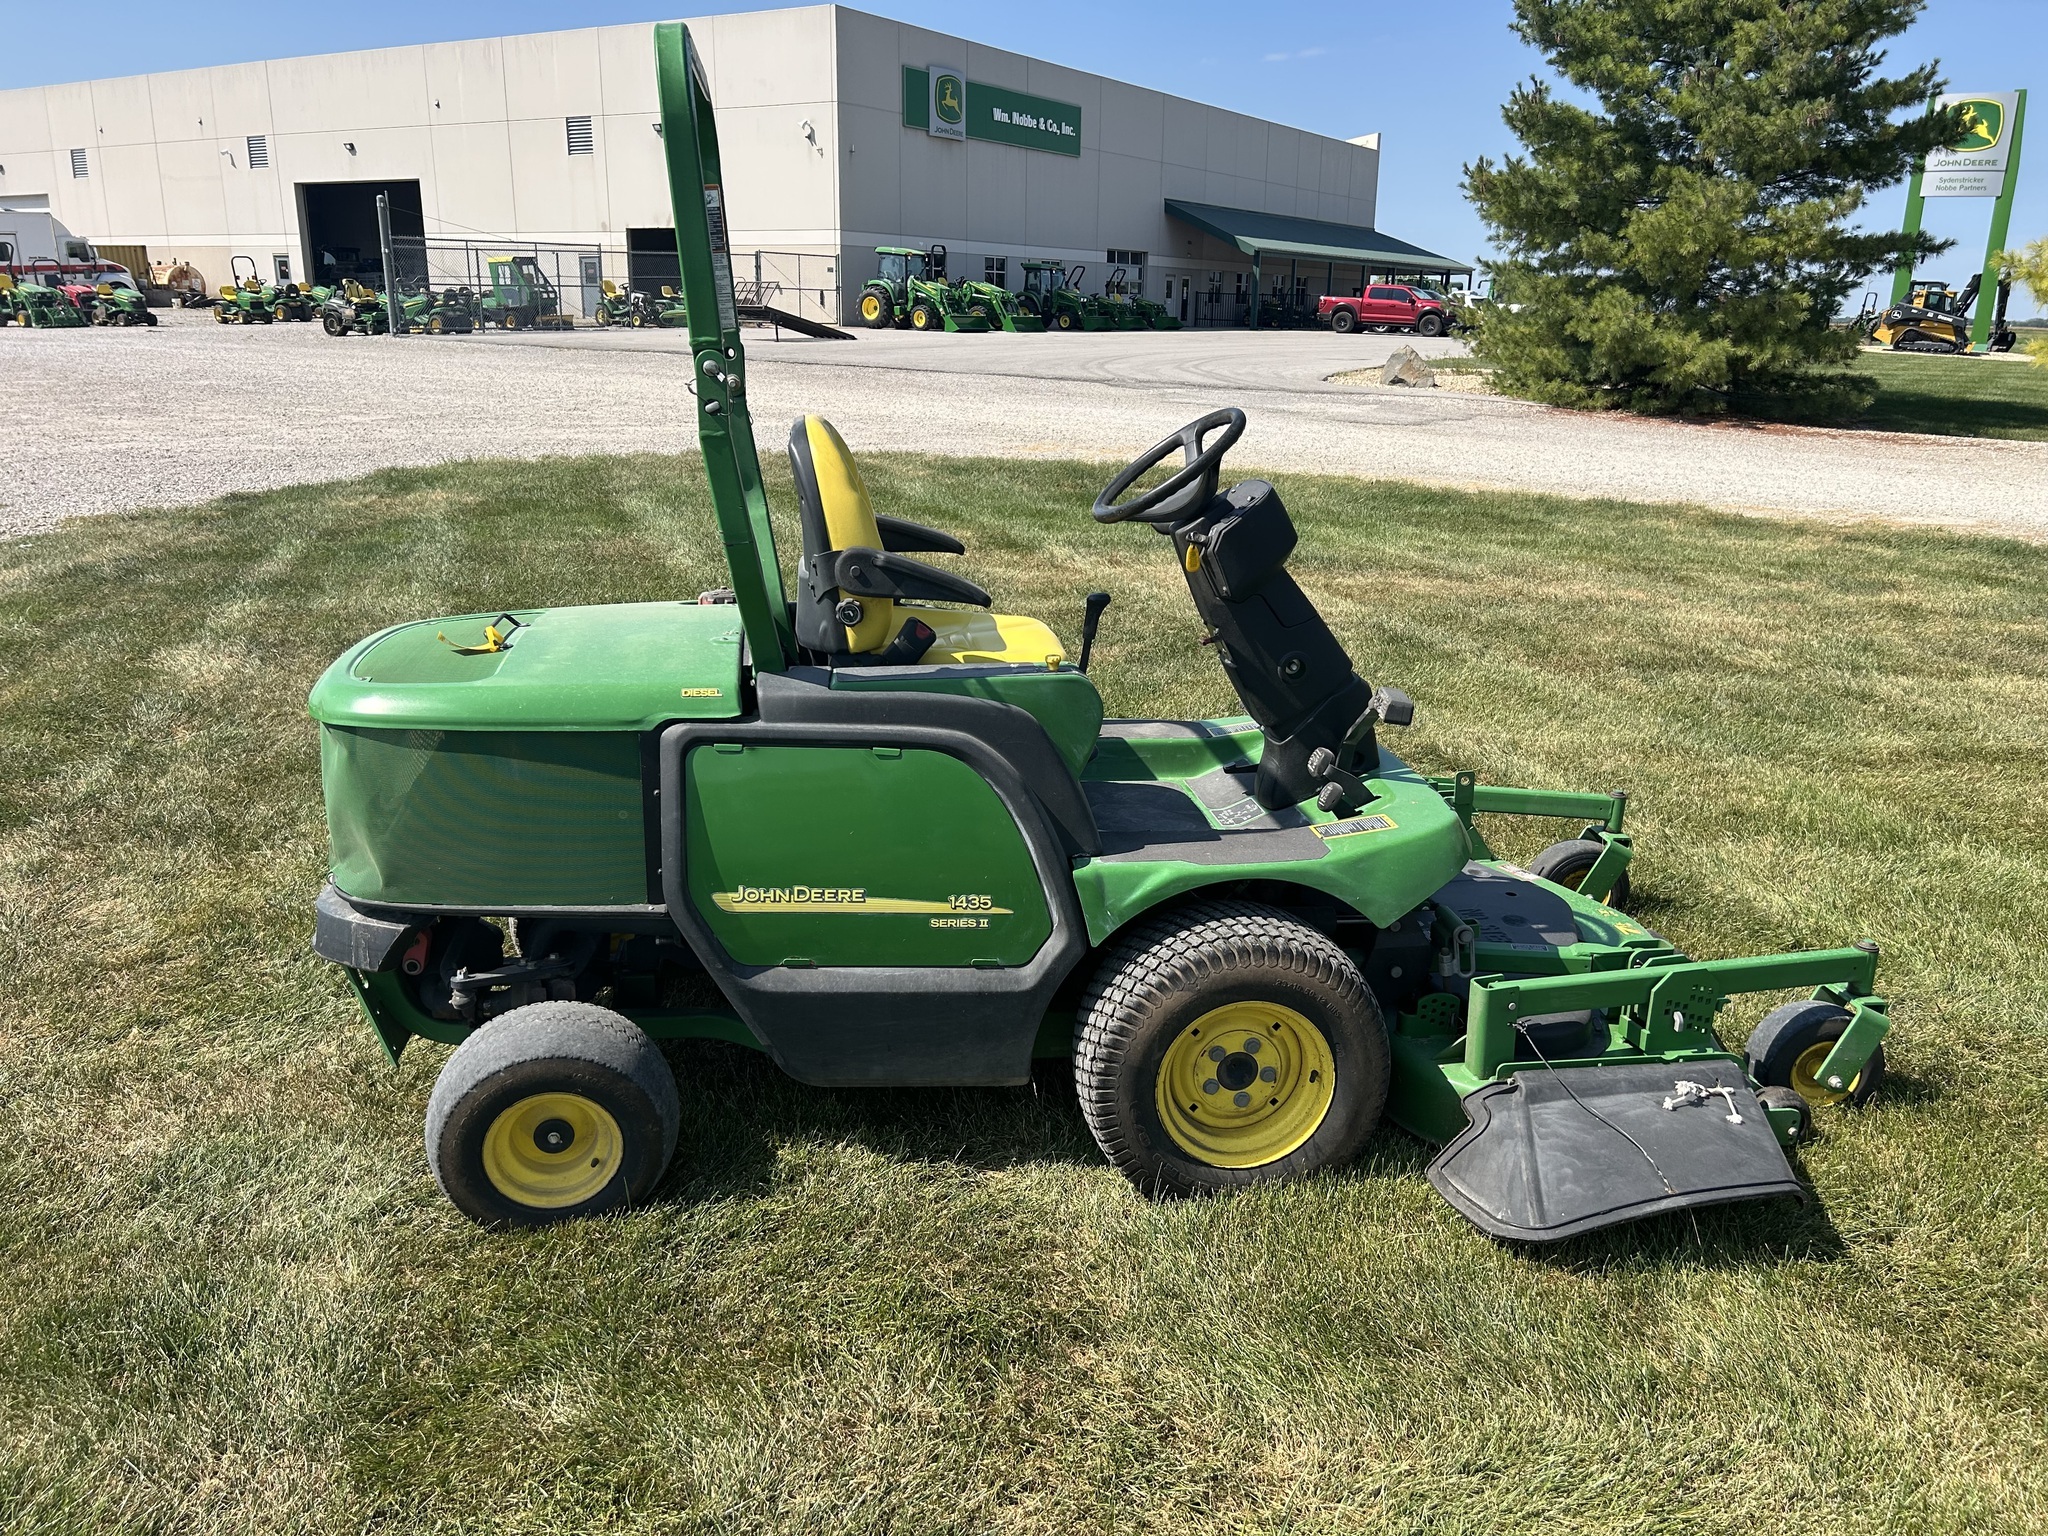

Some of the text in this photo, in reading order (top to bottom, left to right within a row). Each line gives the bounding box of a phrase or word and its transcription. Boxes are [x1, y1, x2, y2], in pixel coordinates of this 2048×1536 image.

[992, 107, 1011, 123] Wm.
[1012, 111, 1037, 129] Nobbe
[1038, 117, 1046, 131] &
[1061, 122, 1076, 137] Inc.
[934, 126, 949, 135] JOHN
[1933, 158, 1999, 167] JOHN DEERE
[1938, 176, 1985, 185] Sydenstricker
[681, 687, 723, 698] DIESEL
[731, 885, 867, 903] JOHN DEERE
[948, 894, 993, 910] 1435
[929, 918, 990, 928] SERIES II
